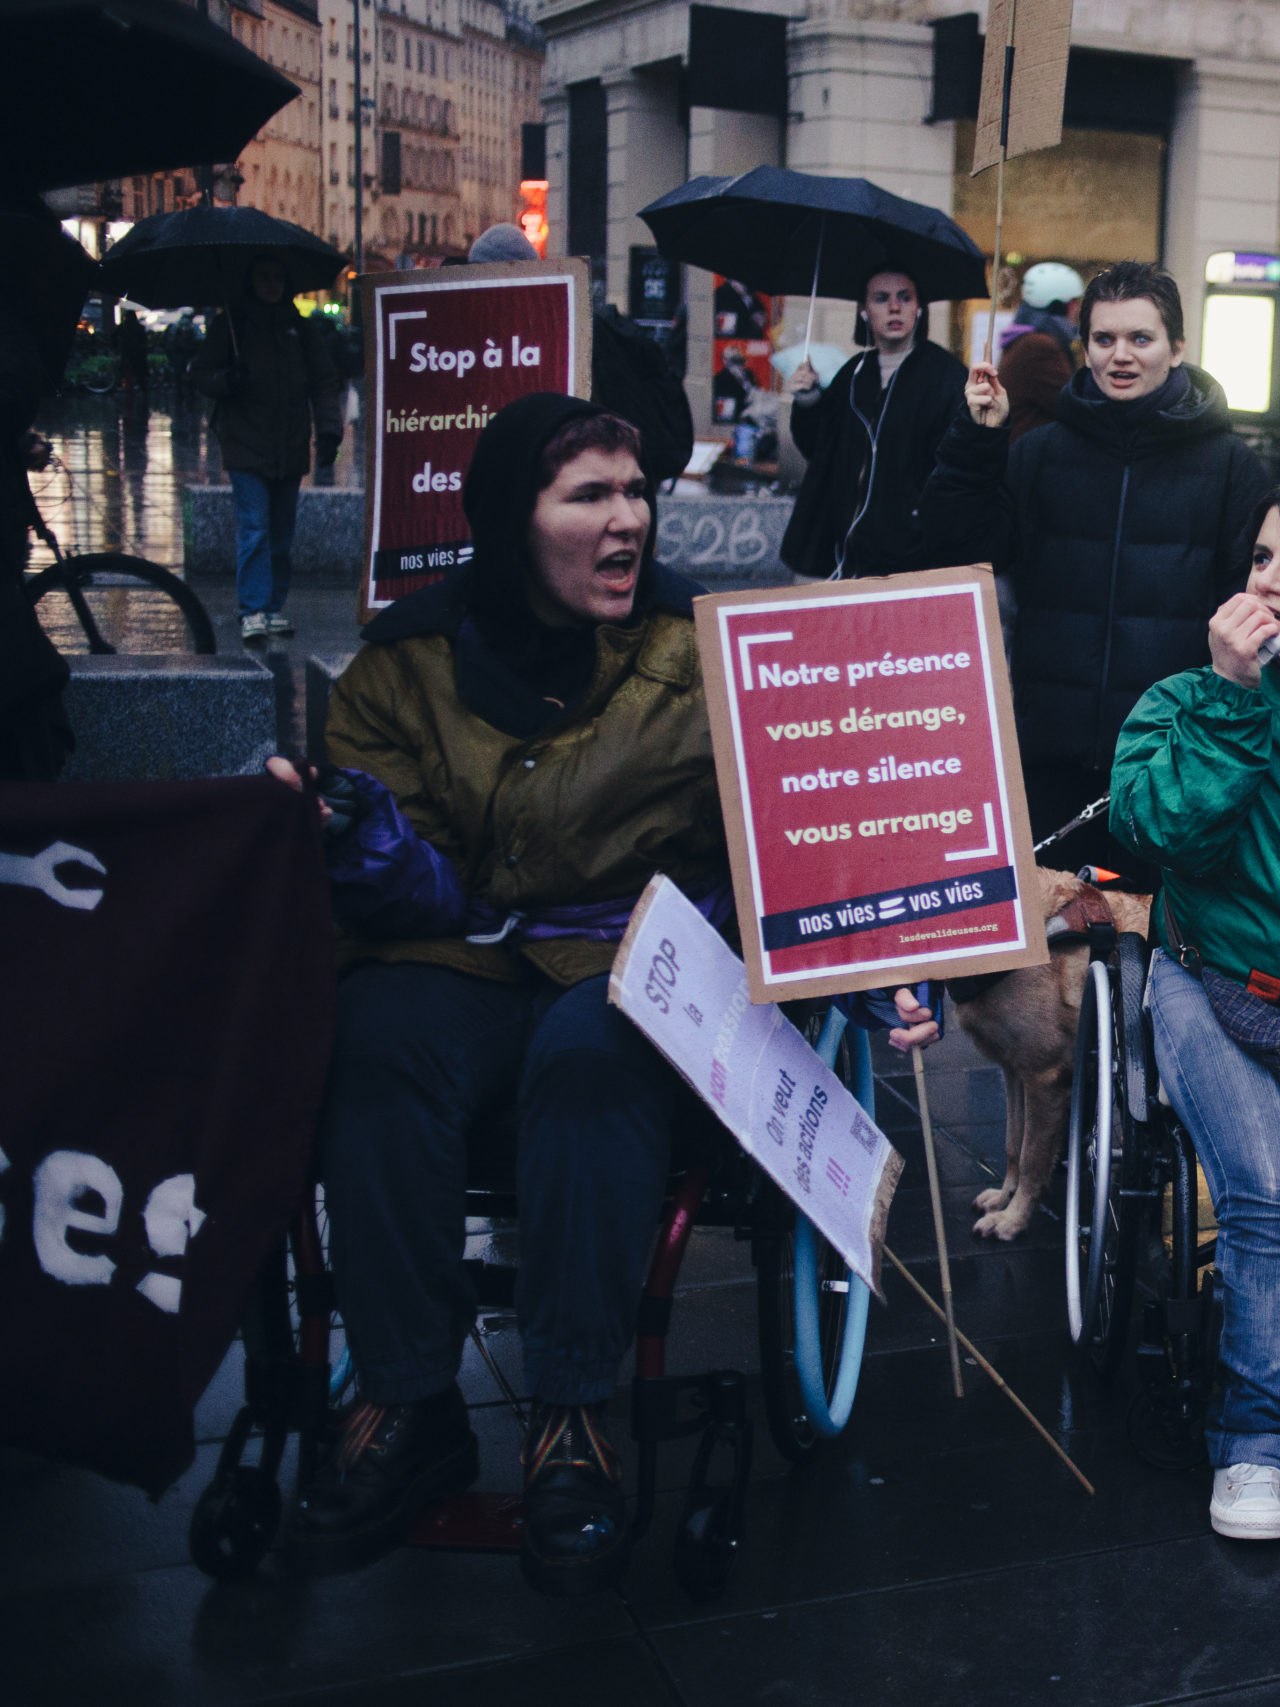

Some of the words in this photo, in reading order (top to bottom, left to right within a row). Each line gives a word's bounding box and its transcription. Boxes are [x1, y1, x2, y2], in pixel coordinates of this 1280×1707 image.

[409, 342, 477, 378] Stop
[483, 338, 503, 369] à
[511, 335, 541, 367] la
[412, 461, 462, 493] des
[400, 553, 423, 571] nos
[427, 548, 455, 567] vies
[757, 662, 840, 689] Notre
[847, 651, 971, 687] présence
[765, 718, 834, 742] vous
[839, 705, 966, 734] dérange,
[781, 767, 860, 794] notre
[867, 755, 962, 784] silence
[784, 823, 853, 846] vous
[858, 808, 974, 838] arrange
[798, 913, 834, 936] nos
[836, 903, 876, 927] vies
[908, 890, 941, 912] vos
[944, 881, 984, 906] vies
[898, 923, 999, 943] lesdevalideuses.org
[645, 938, 680, 1014] STOP
[682, 1003, 704, 1028] la
[773, 1068, 797, 1118] veut
[765, 1115, 785, 1147] On
[798, 1084, 829, 1161] actions
[793, 1156, 811, 1194] des
